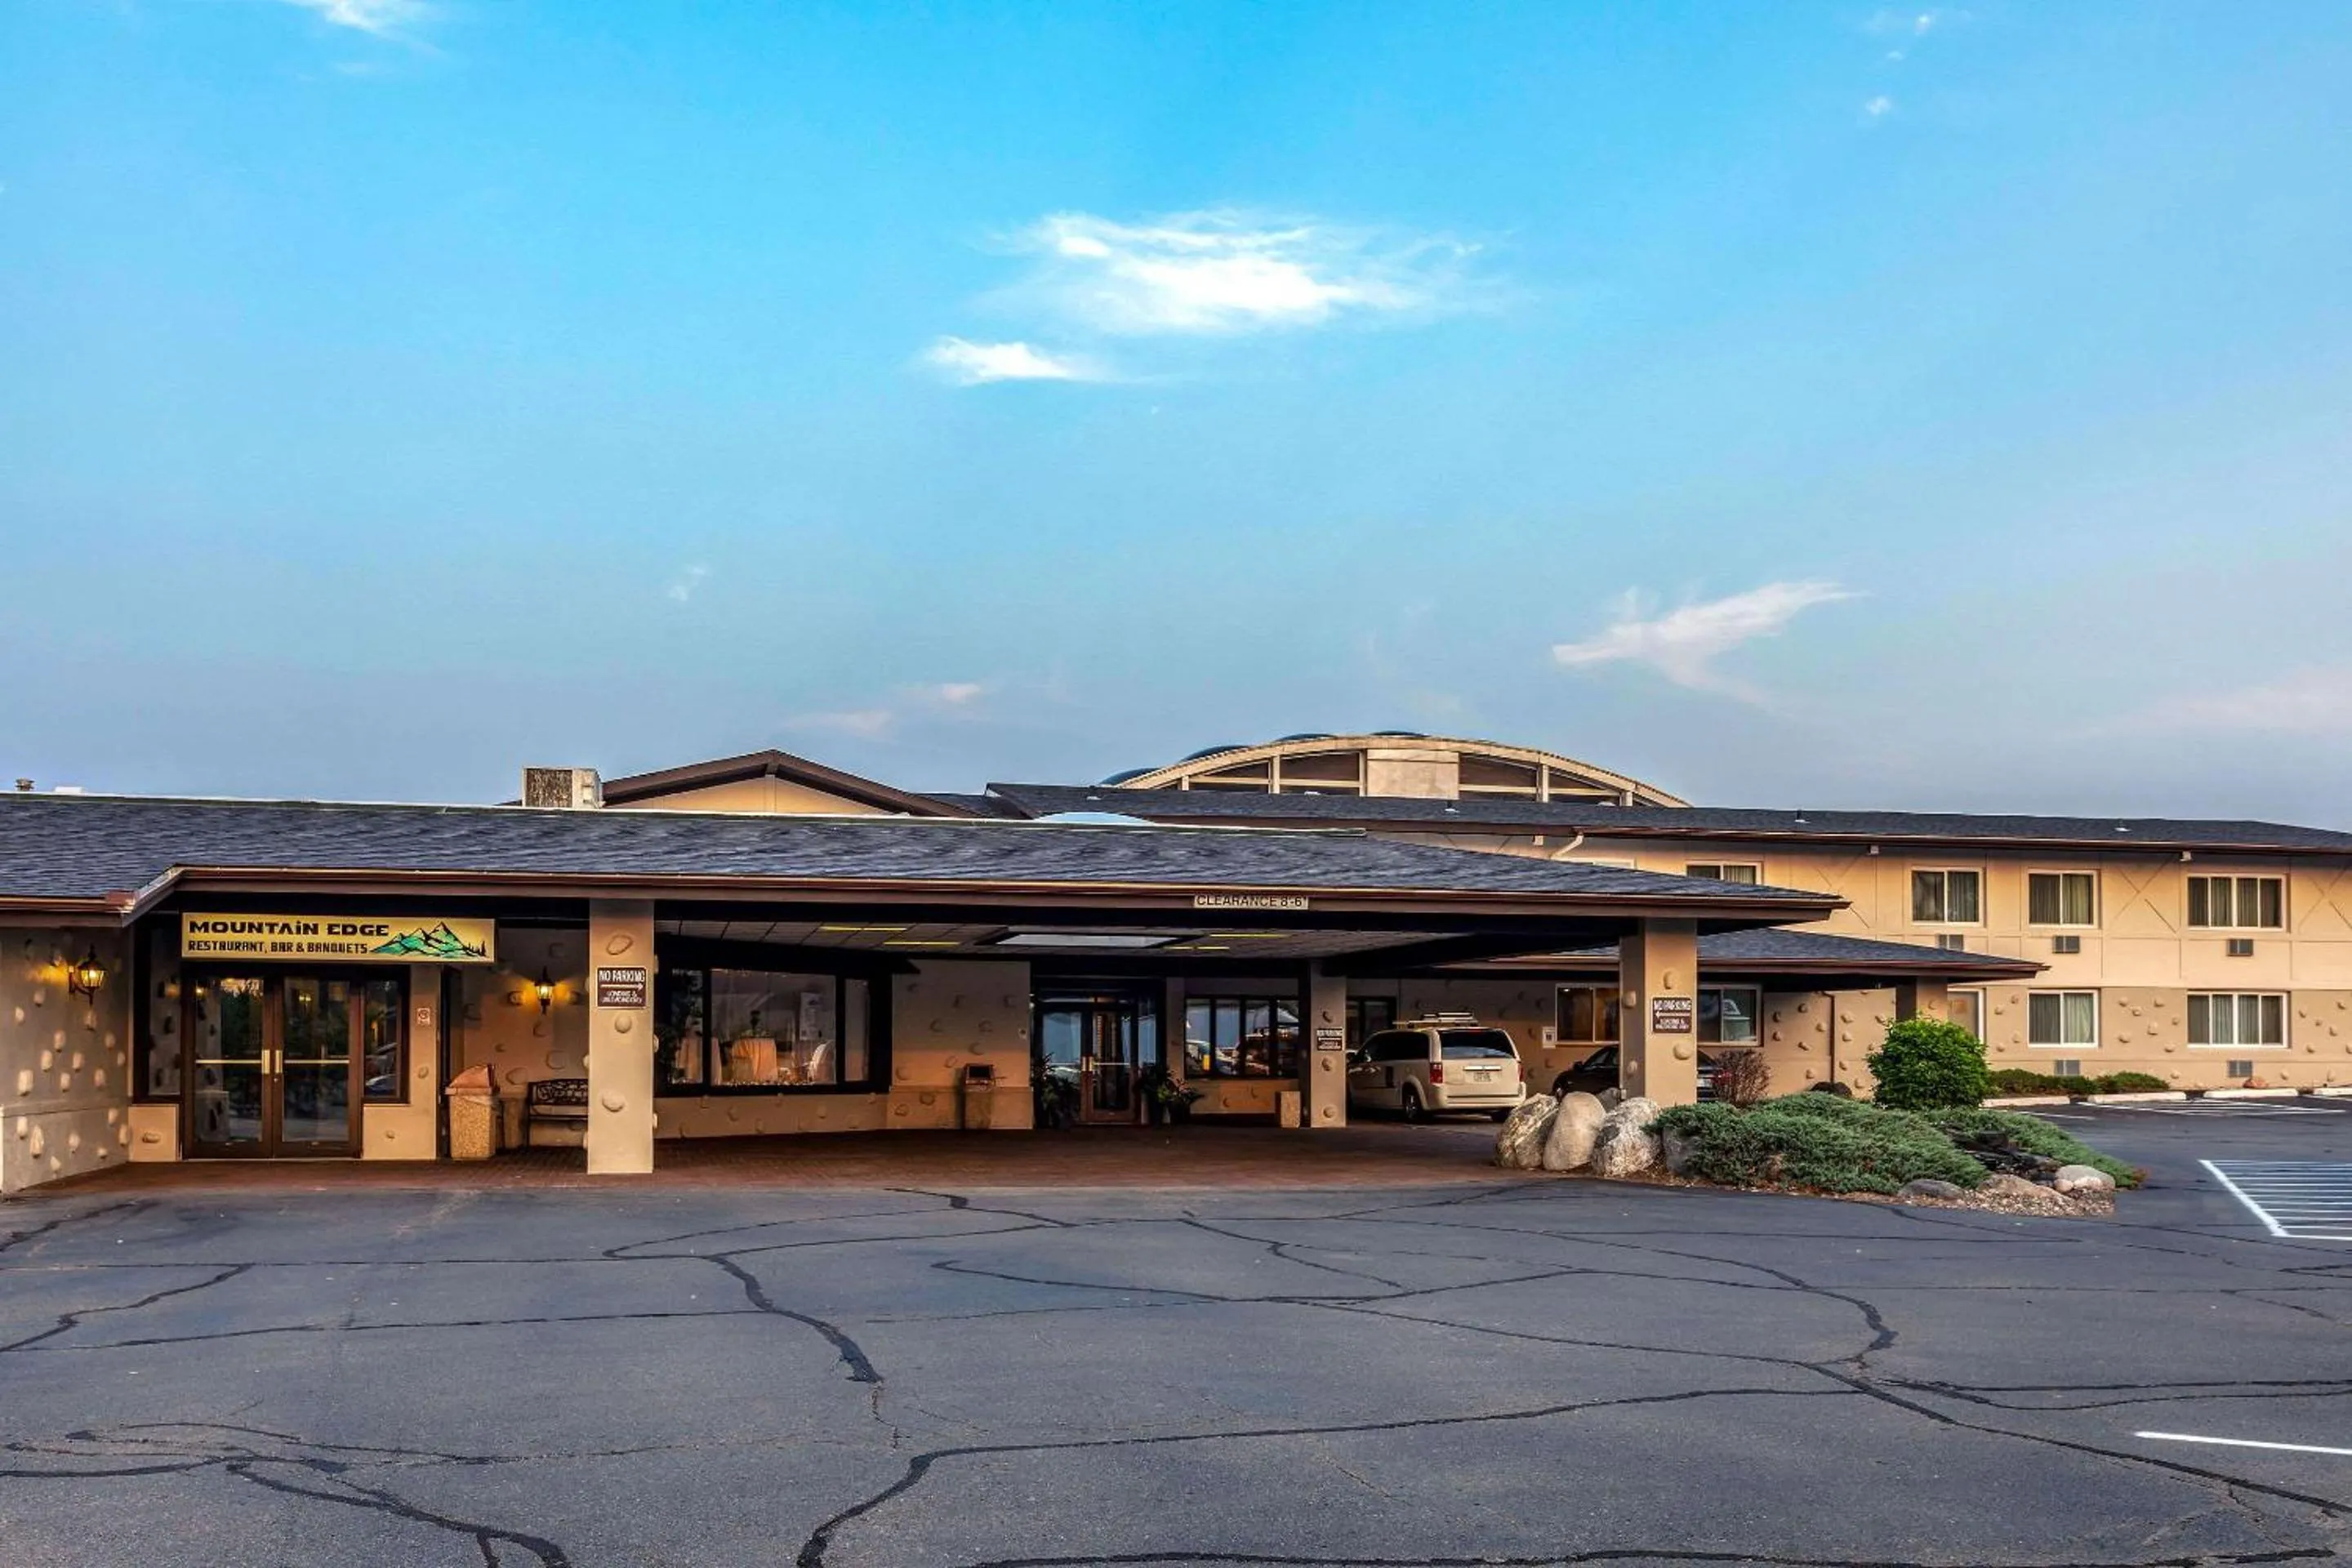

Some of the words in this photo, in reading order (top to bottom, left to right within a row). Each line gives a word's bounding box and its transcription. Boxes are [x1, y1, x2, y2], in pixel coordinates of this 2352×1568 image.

[1196, 895, 1277, 907] CLEARANCE
[327, 923, 390, 937] EDGE
[188, 940, 268, 954] RESTAURANT,
[270, 942, 293, 952] BAR
[296, 942, 305, 953] &
[306, 942, 368, 954] BANQUETS
[599, 970, 611, 982] NO
[612, 970, 645, 982] PARKING
